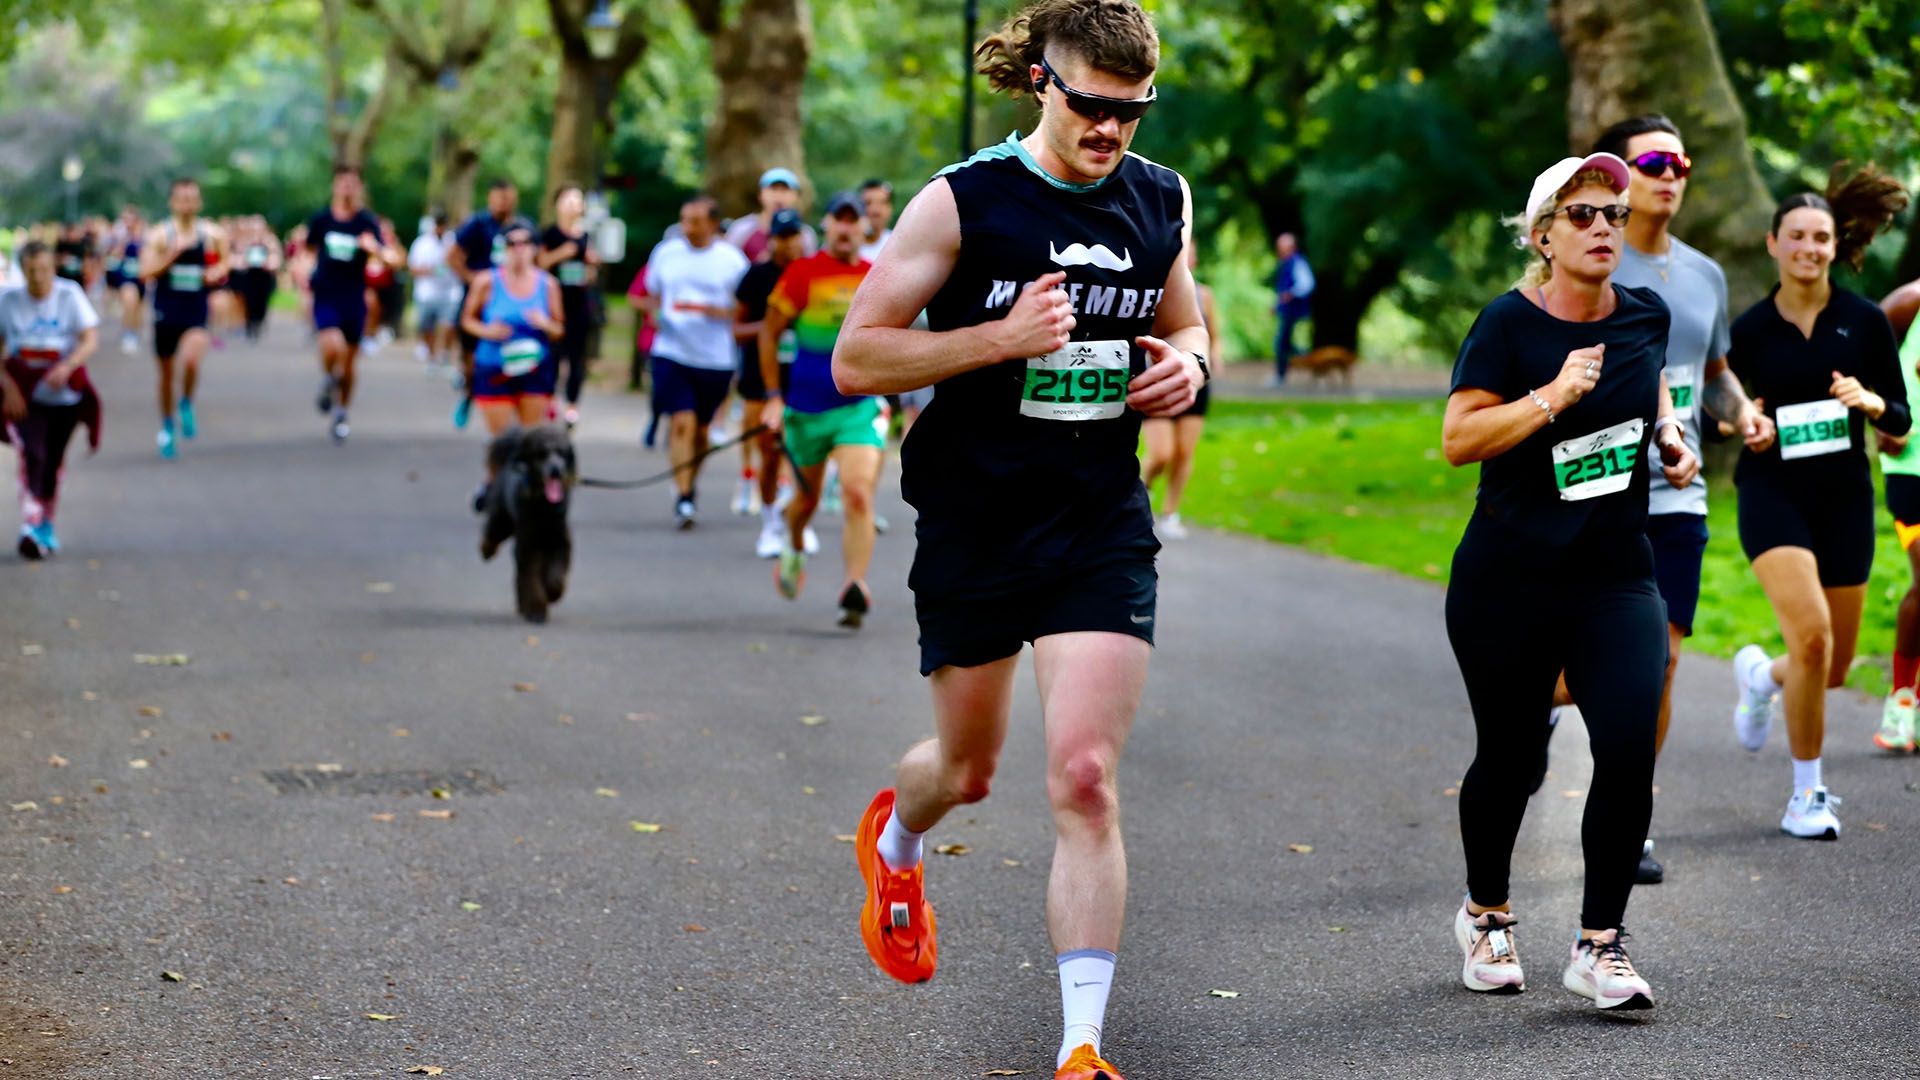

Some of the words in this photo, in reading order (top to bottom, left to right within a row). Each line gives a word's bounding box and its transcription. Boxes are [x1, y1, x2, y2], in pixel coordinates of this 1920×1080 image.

[1030, 369, 1123, 403] 2195
[1784, 418, 1847, 446] 2198
[1563, 443, 1641, 488] 2313
